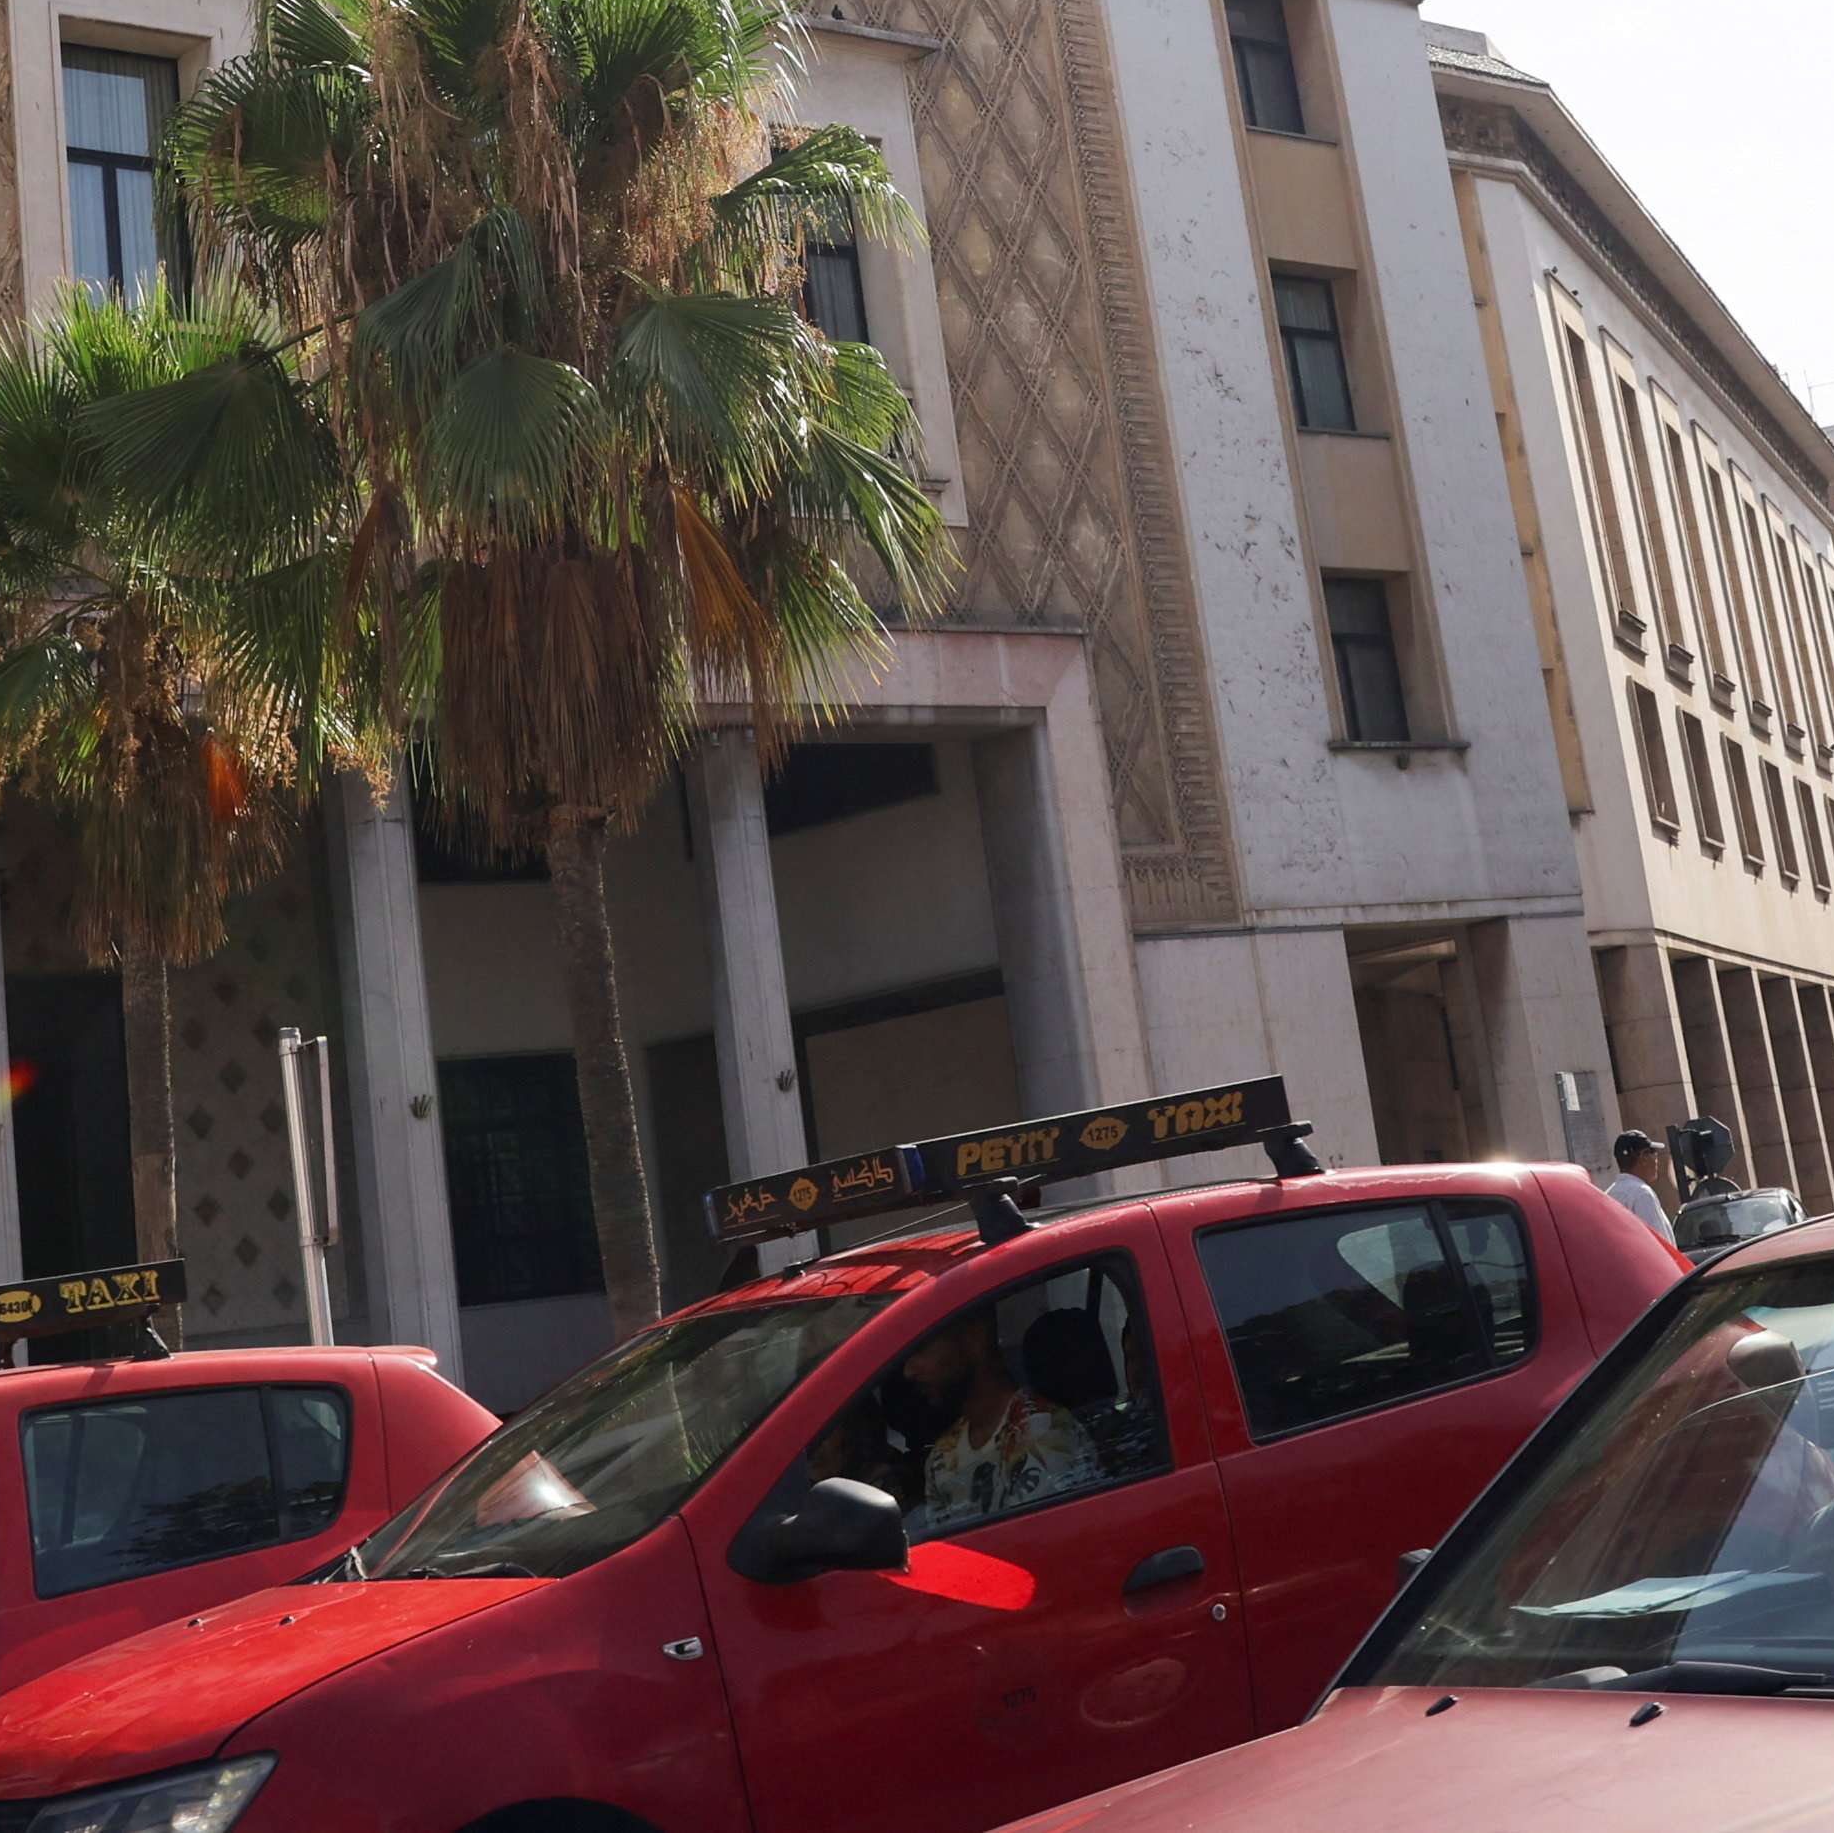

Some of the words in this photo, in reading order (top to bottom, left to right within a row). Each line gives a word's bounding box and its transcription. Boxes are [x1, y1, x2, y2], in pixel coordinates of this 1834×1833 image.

[956, 1126, 1060, 1176] PETIT
[1087, 1124, 1118, 1141] 1275
[1147, 1091, 1244, 1139] TAXI
[793, 1187, 813, 1203] 1275
[59, 1269, 162, 1313] TAXI
